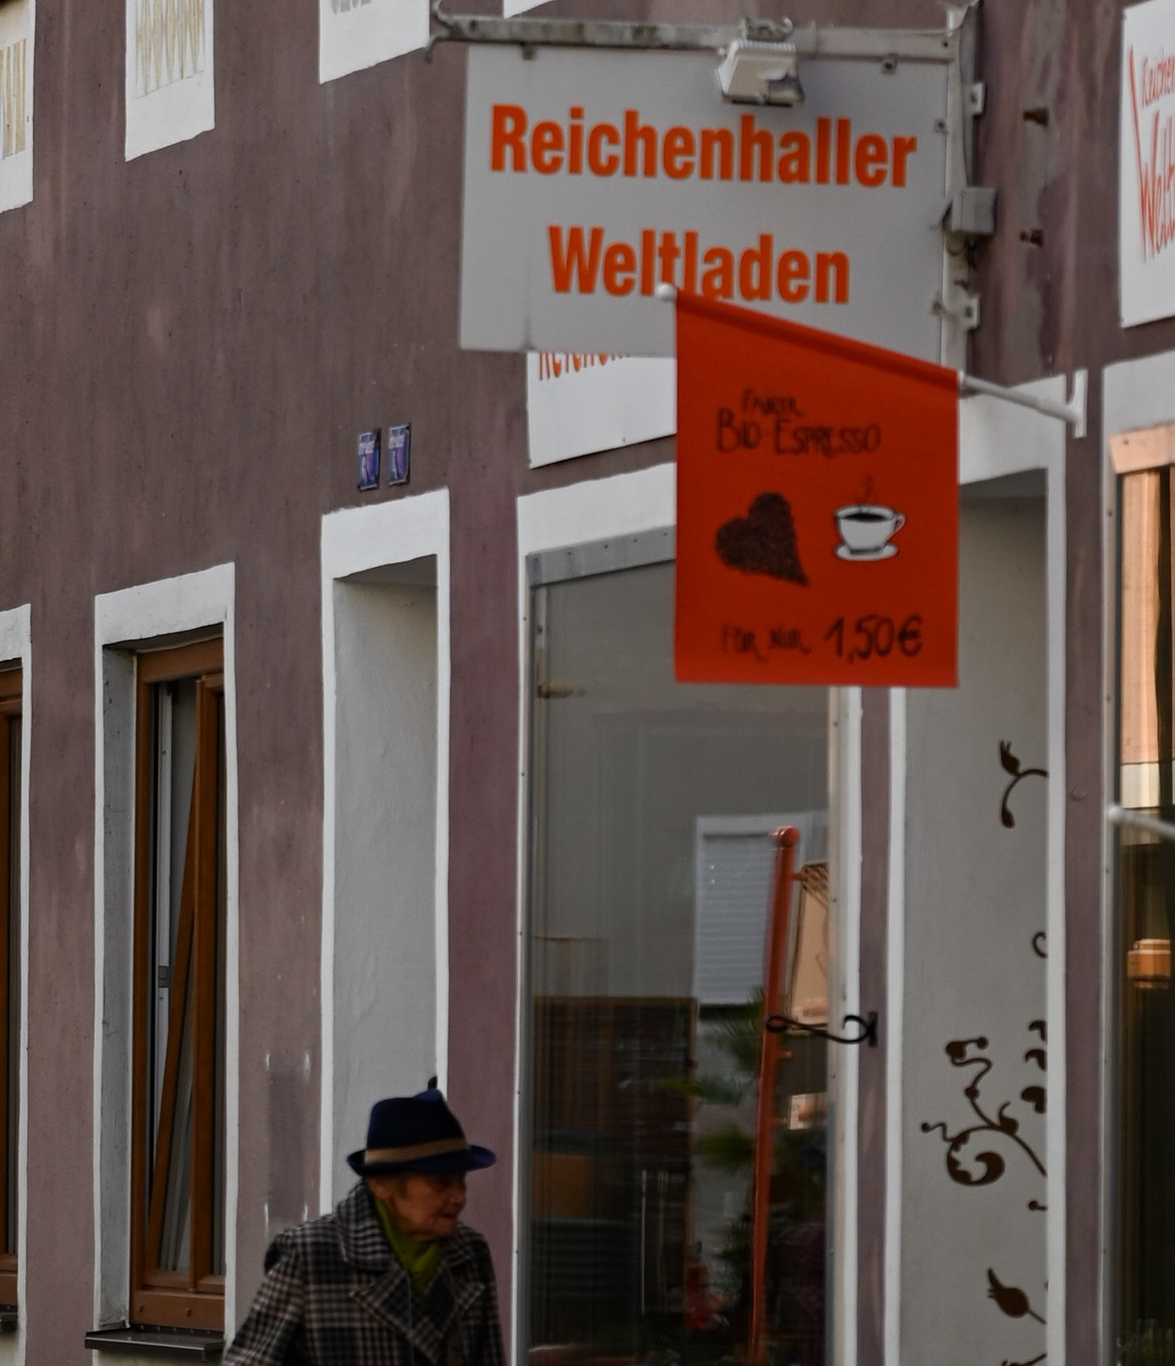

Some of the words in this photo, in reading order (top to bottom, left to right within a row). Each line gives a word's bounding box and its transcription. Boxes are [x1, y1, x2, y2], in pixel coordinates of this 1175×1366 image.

[491, 103, 918, 188] Reichenhaller
[548, 224, 851, 305] Weltladen
[825, 614, 924, 664] 1,50€
